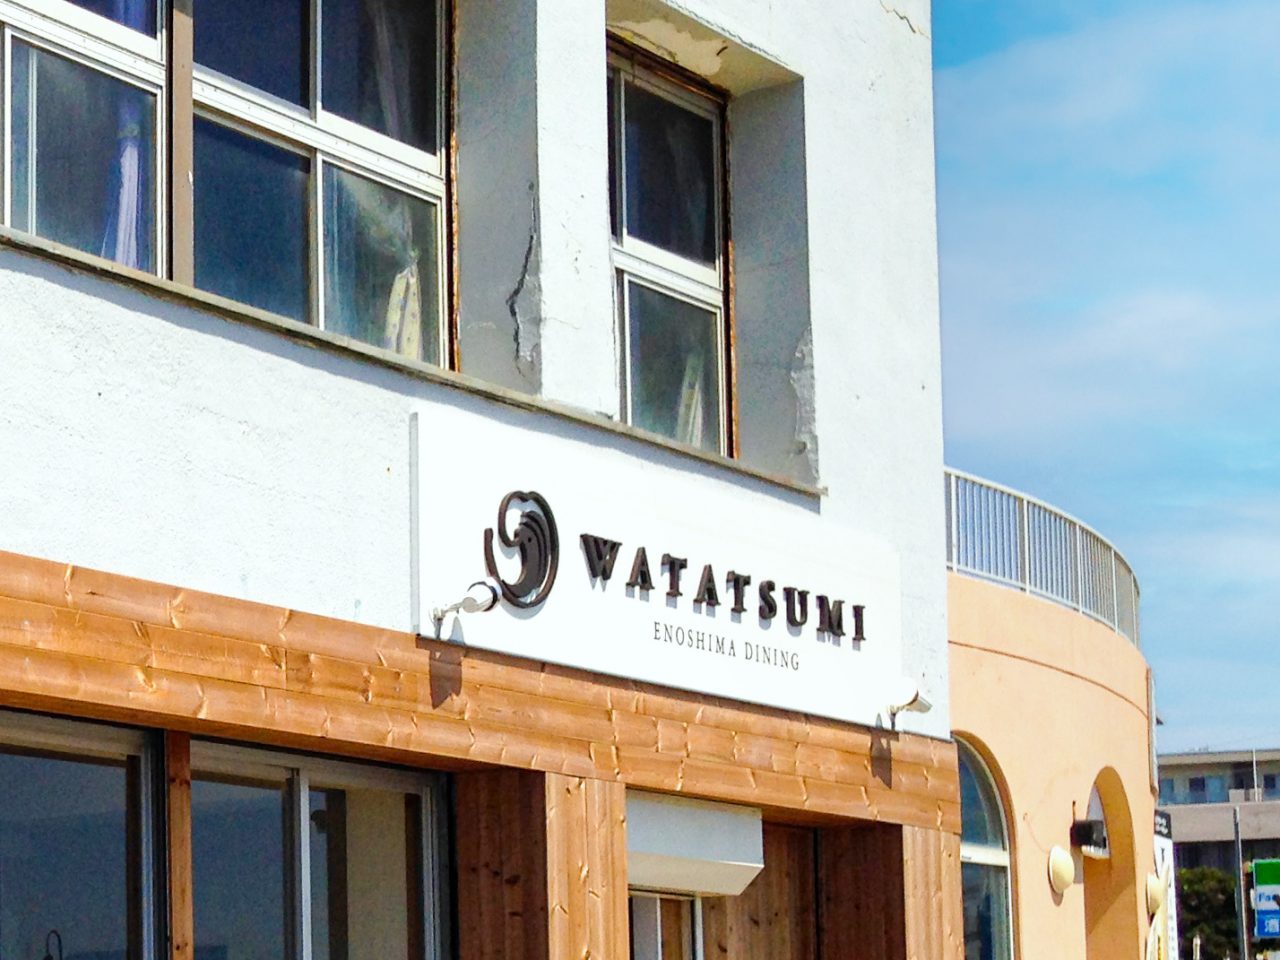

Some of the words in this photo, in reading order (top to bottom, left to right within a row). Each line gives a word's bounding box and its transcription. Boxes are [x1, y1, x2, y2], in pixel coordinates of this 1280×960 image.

[580, 533, 866, 642] WATATSUMI
[653, 621, 738, 658] ENOSHIMA
[744, 641, 800, 671] DINING
